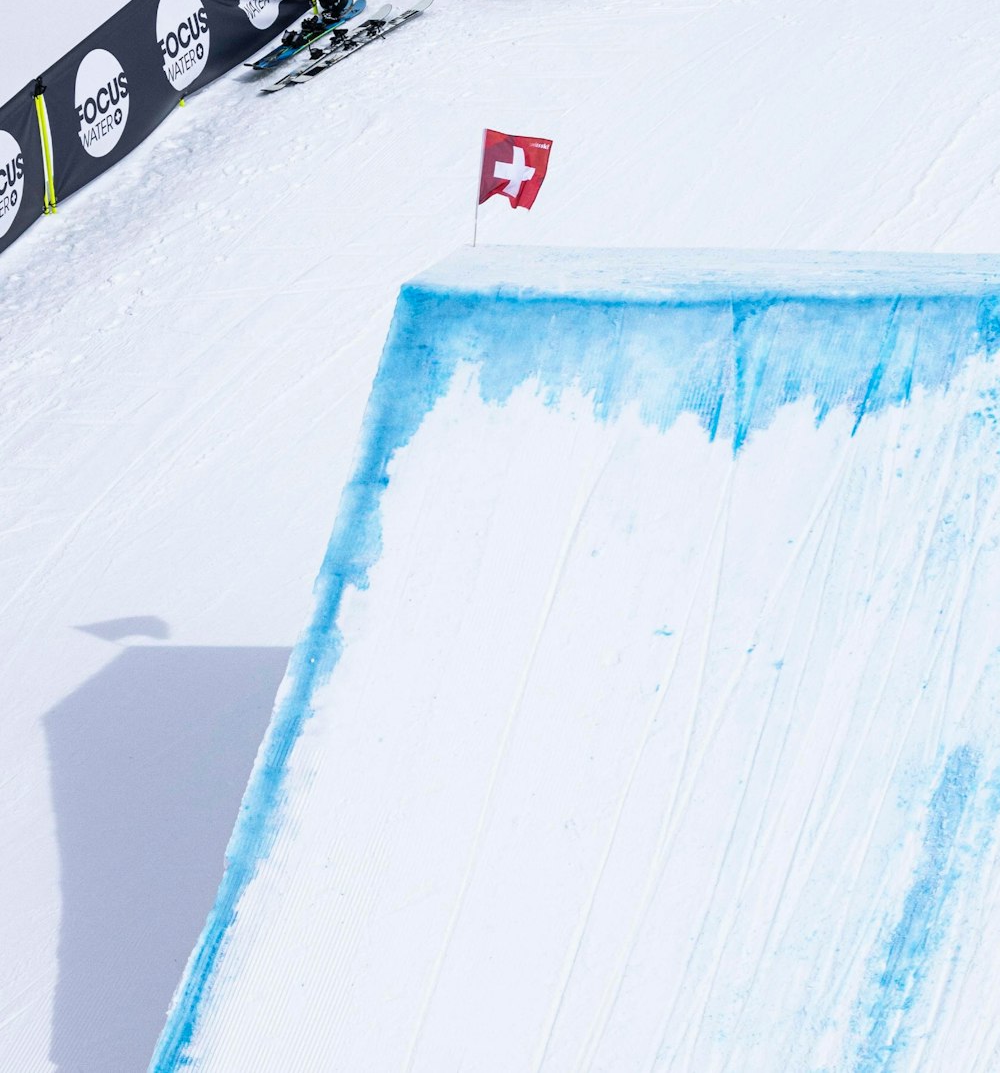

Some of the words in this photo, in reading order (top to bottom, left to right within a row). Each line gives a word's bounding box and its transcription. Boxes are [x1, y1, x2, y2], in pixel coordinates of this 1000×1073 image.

[157, 7, 209, 62] FOCUS
[167, 49, 196, 82] WATER
[75, 72, 128, 129] FOCUS
[82, 115, 114, 147] WATER
